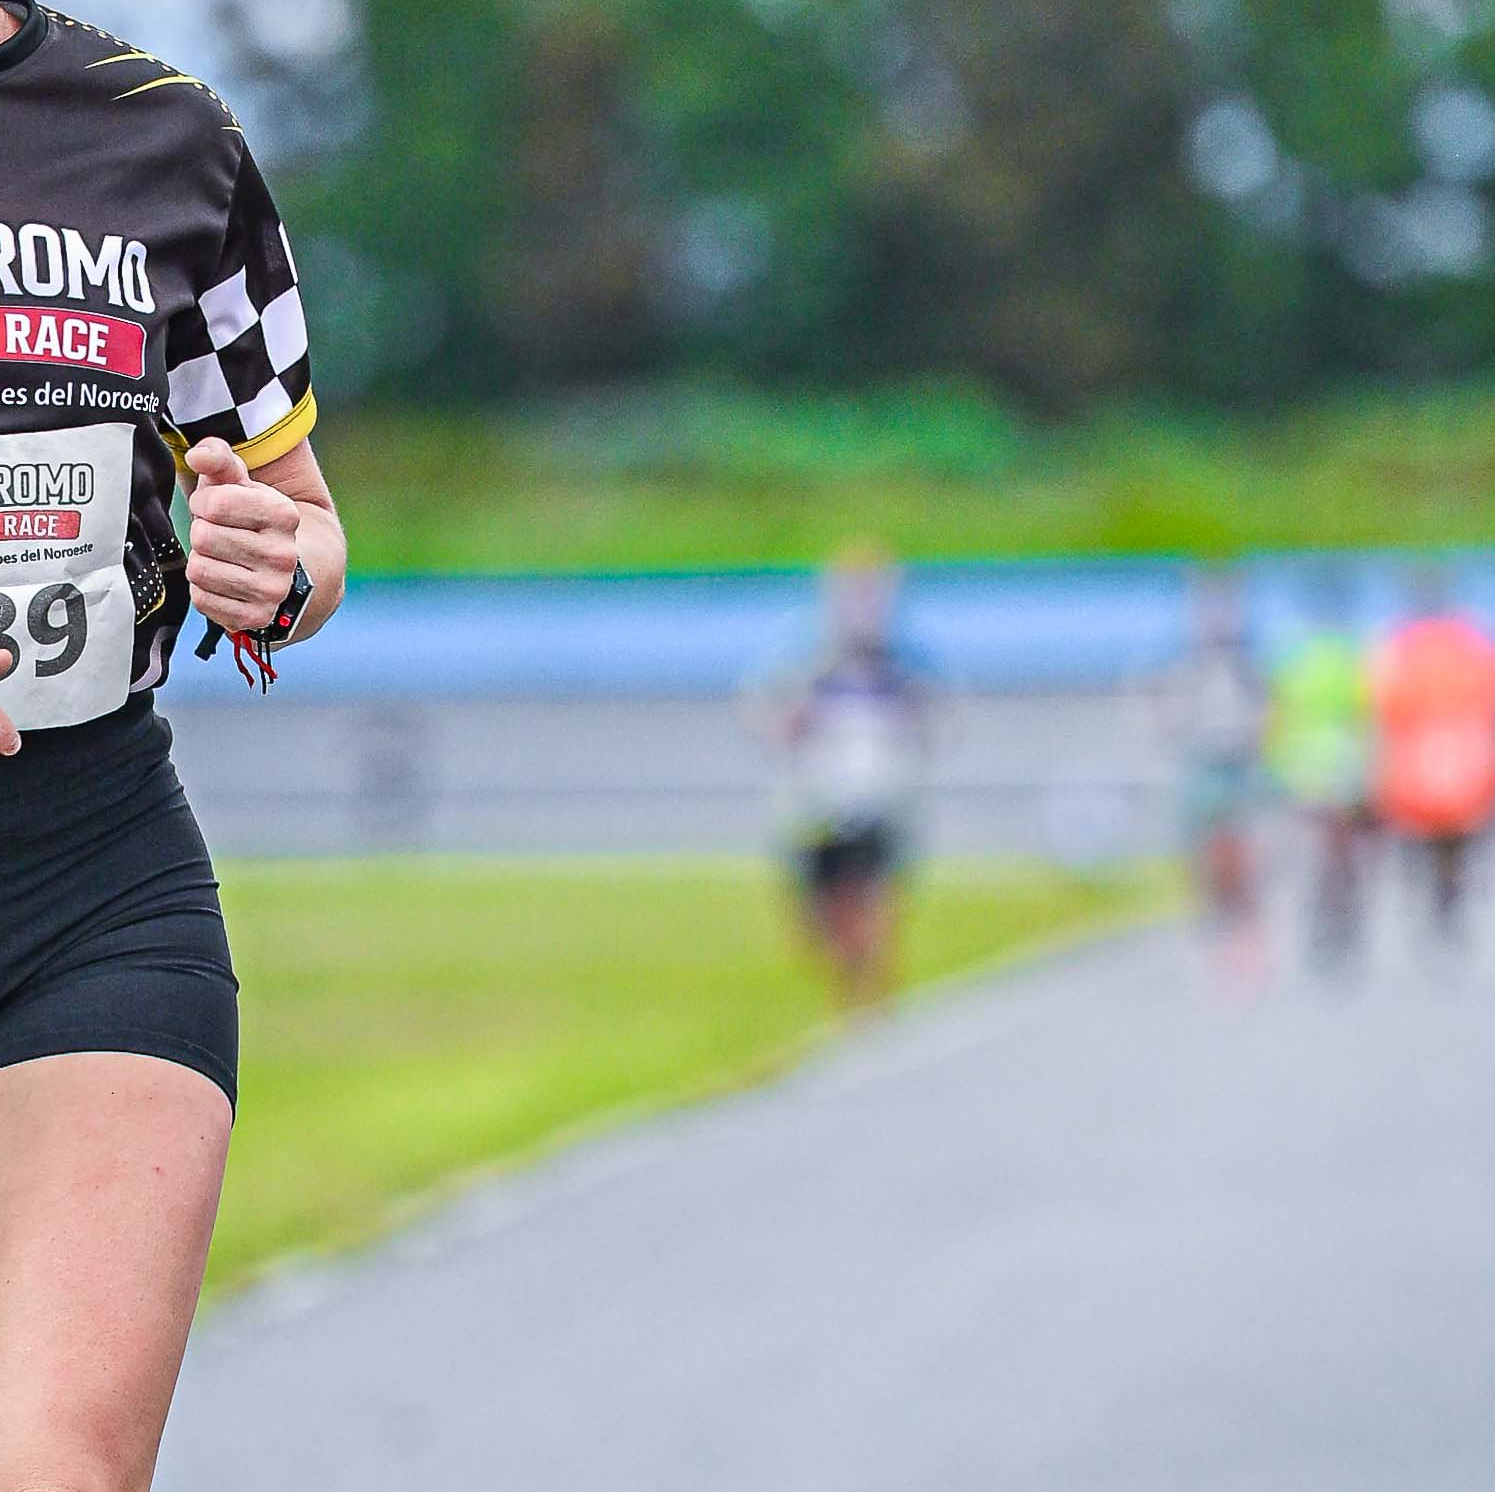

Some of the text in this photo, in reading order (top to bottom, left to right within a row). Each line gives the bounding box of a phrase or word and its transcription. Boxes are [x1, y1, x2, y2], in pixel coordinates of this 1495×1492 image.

[5, 313, 110, 366] RACE
[34, 381, 74, 406] del
[79, 382, 160, 414] Noroeste
[4, 512, 60, 539] RACE
[20, 549, 41, 563] del
[44, 542, 94, 561] Noroeste
